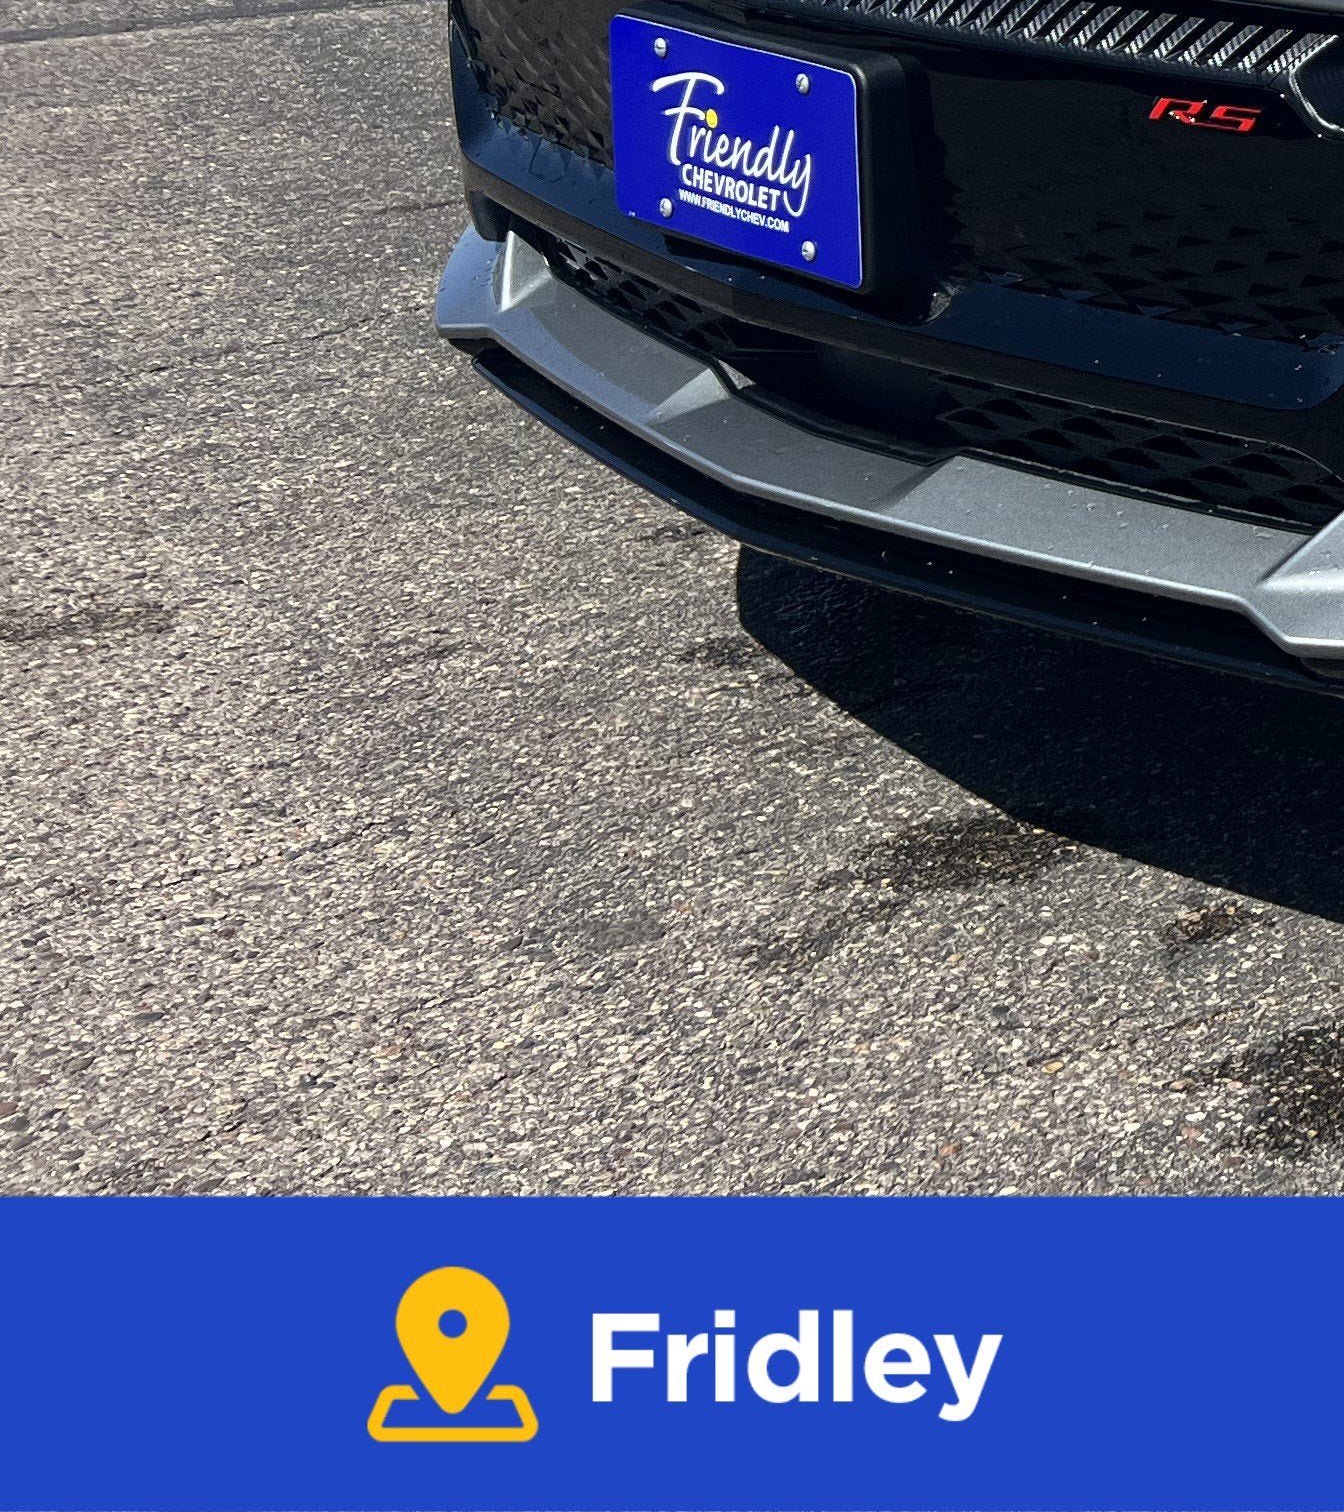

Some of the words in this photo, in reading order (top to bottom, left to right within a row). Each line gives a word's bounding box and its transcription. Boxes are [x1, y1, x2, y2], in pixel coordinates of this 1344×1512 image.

[1148, 97, 1261, 133] RS
[652, 72, 811, 217] Friendly
[679, 188, 789, 233] WWW.FRIENDLYCHEV.COM
[682, 164, 781, 211] CHEVROLET
